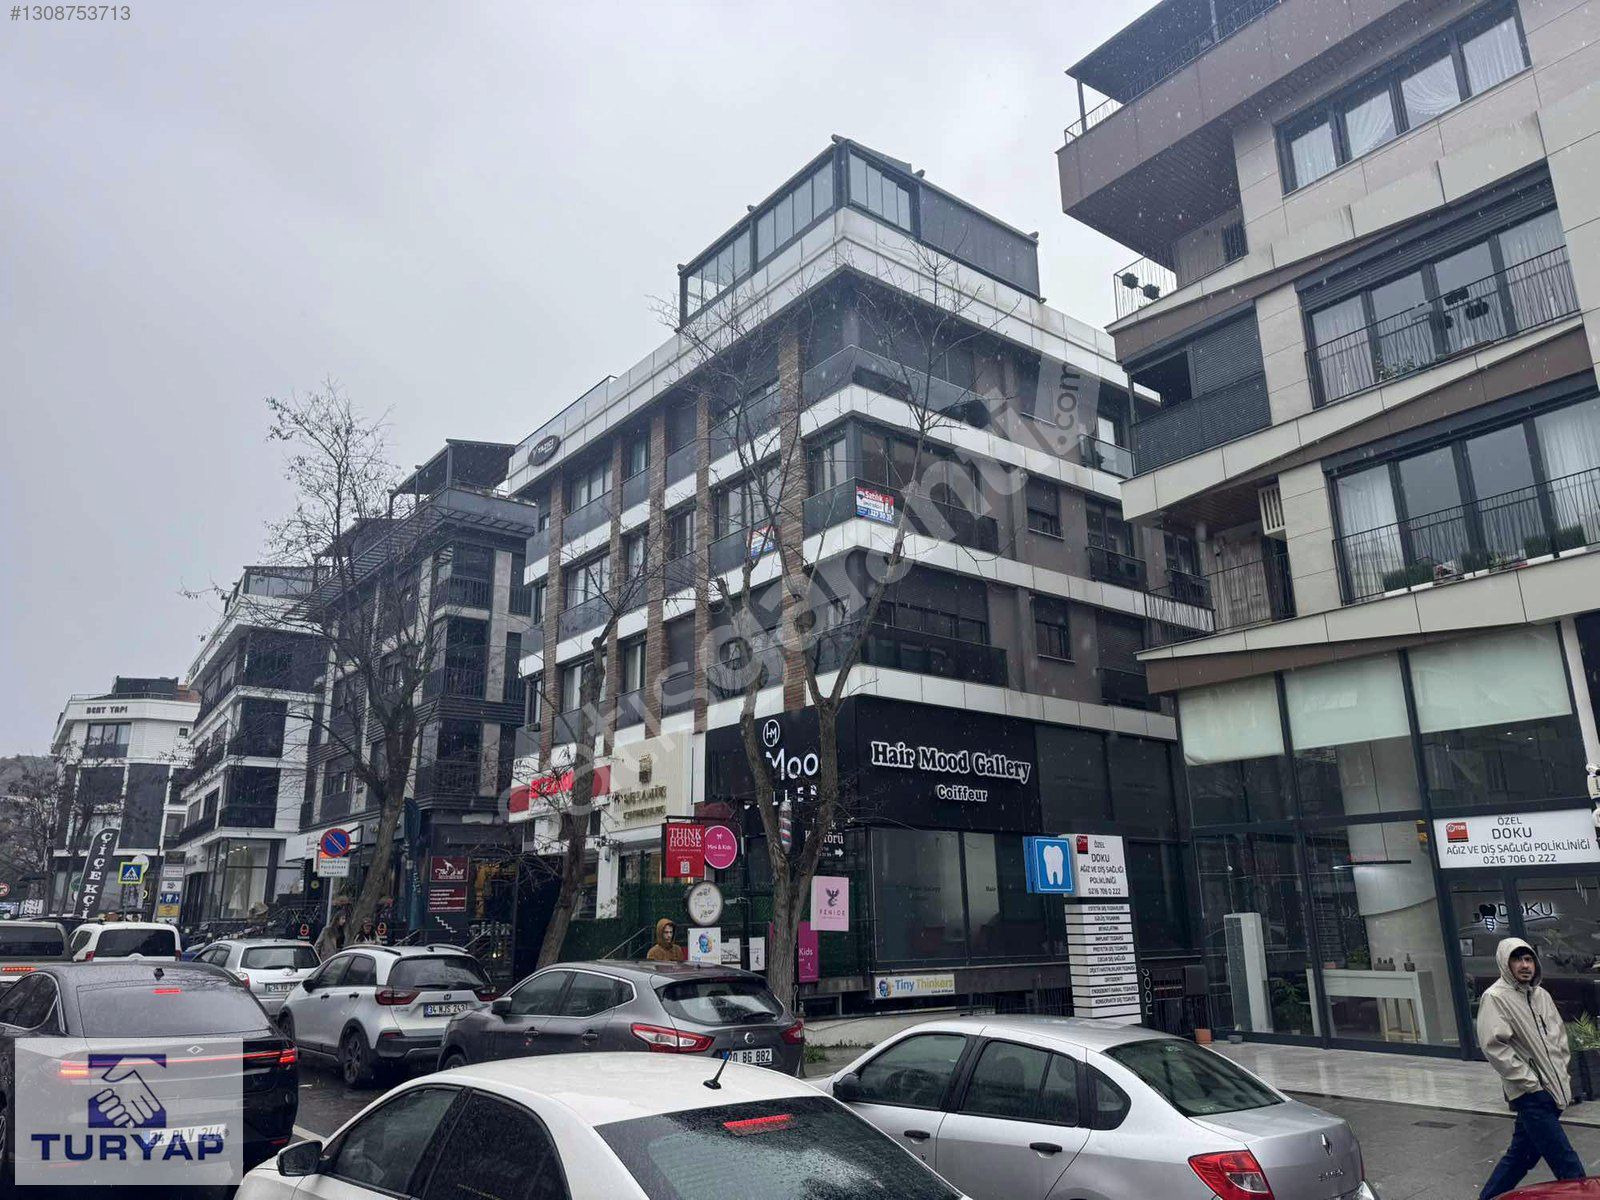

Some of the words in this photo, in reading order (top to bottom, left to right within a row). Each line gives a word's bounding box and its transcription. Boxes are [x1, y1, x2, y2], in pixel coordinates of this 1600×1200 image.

[871, 741, 915, 768] Hair
[918, 746, 970, 774] Mood
[972, 752, 1031, 784] Gallery
[936, 784, 988, 802] Coiffeur
[1497, 816, 1522, 826] ÖZEL
[668, 828, 702, 840] THINK
[1492, 827, 1532, 840] DOKU
[670, 837, 702, 848] HOUSE
[1446, 844, 1466, 855] AĞIZ
[1467, 845, 1479, 854] VE
[1481, 843, 1496, 856] DİŞ
[1498, 841, 1533, 853] SAĞLIĞI
[1534, 839, 1591, 851] POLİKLİNİĞİ
[1091, 853, 1110, 862] DOKU
[1483, 855, 1506, 864] 0216
[1509, 855, 1526, 863] 706
[1528, 854, 1536, 863] 0
[1538, 854, 1557, 862] 222
[799, 947, 813, 956] Kids
[895, 979, 915, 992] Tiny
[917, 978, 953, 989] Thinkers
[756, 1050, 771, 1061] 882
